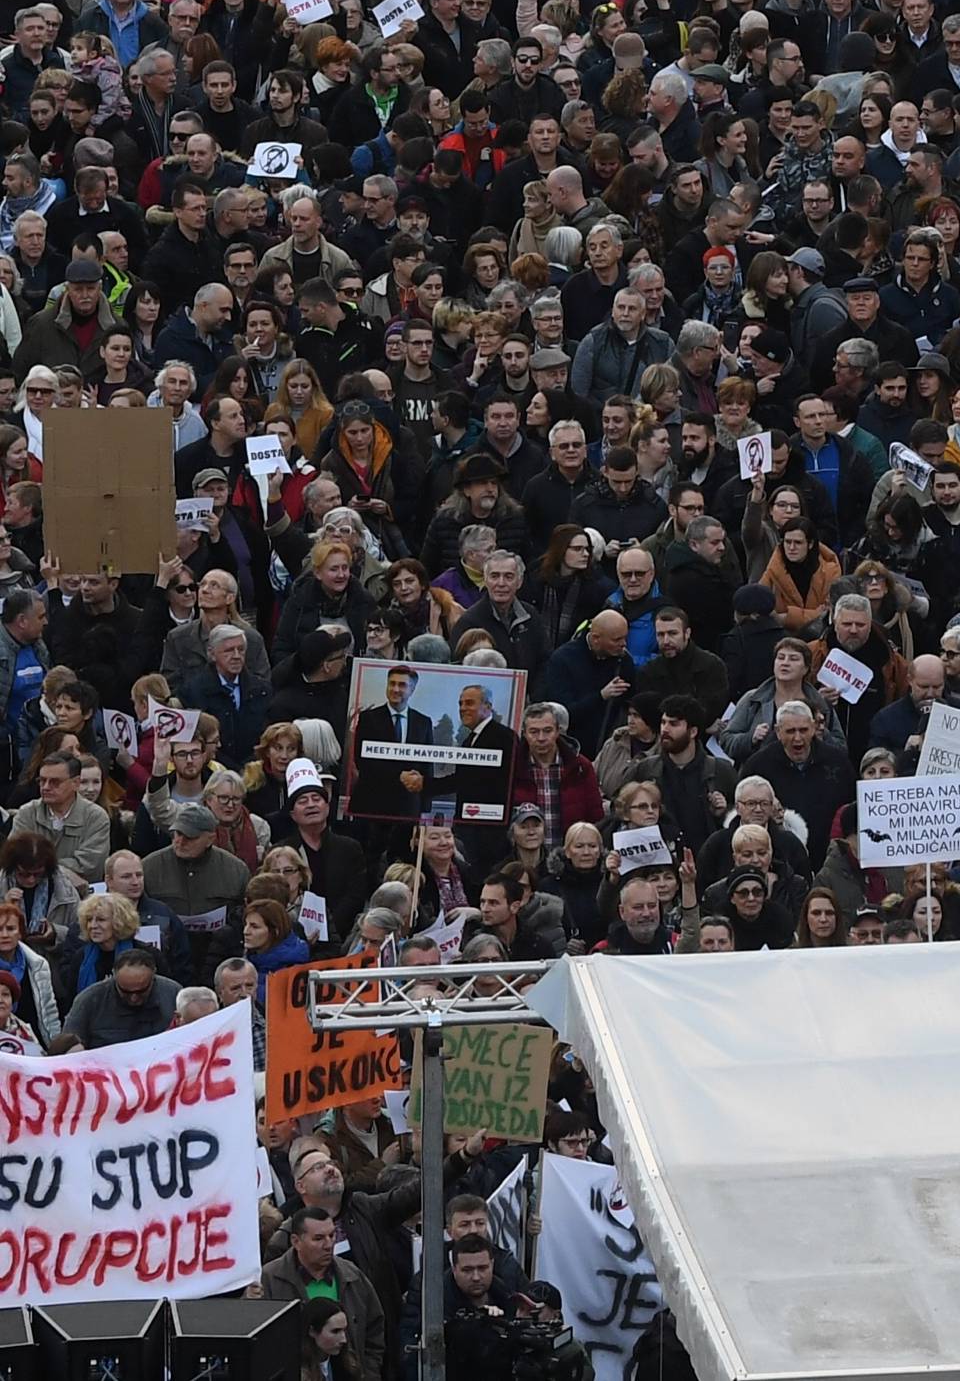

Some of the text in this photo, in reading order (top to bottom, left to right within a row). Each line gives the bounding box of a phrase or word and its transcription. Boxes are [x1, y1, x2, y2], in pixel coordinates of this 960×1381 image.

[288, 1, 311, 17] OSTA
[381, 6, 404, 26] DOSTA
[402, 399, 440, 421] RMY
[174, 511, 195, 522] STA
[825, 659, 852, 684] DOSTA
[366, 745, 498, 762] MEET THE MAYOR'S PARTNER
[289, 769, 314, 784] OSTA
[864, 791, 883, 803] NE
[888, 786, 934, 801] TREBA
[889, 813, 956, 829] MI IMAMO
[896, 827, 950, 843] MILANA
[886, 839, 960, 857] BANDIĆA!!!
[440, 936, 460, 953] STA
[504, 1075, 530, 1103] IZ
[0, 1129, 220, 1212] SU STUP
